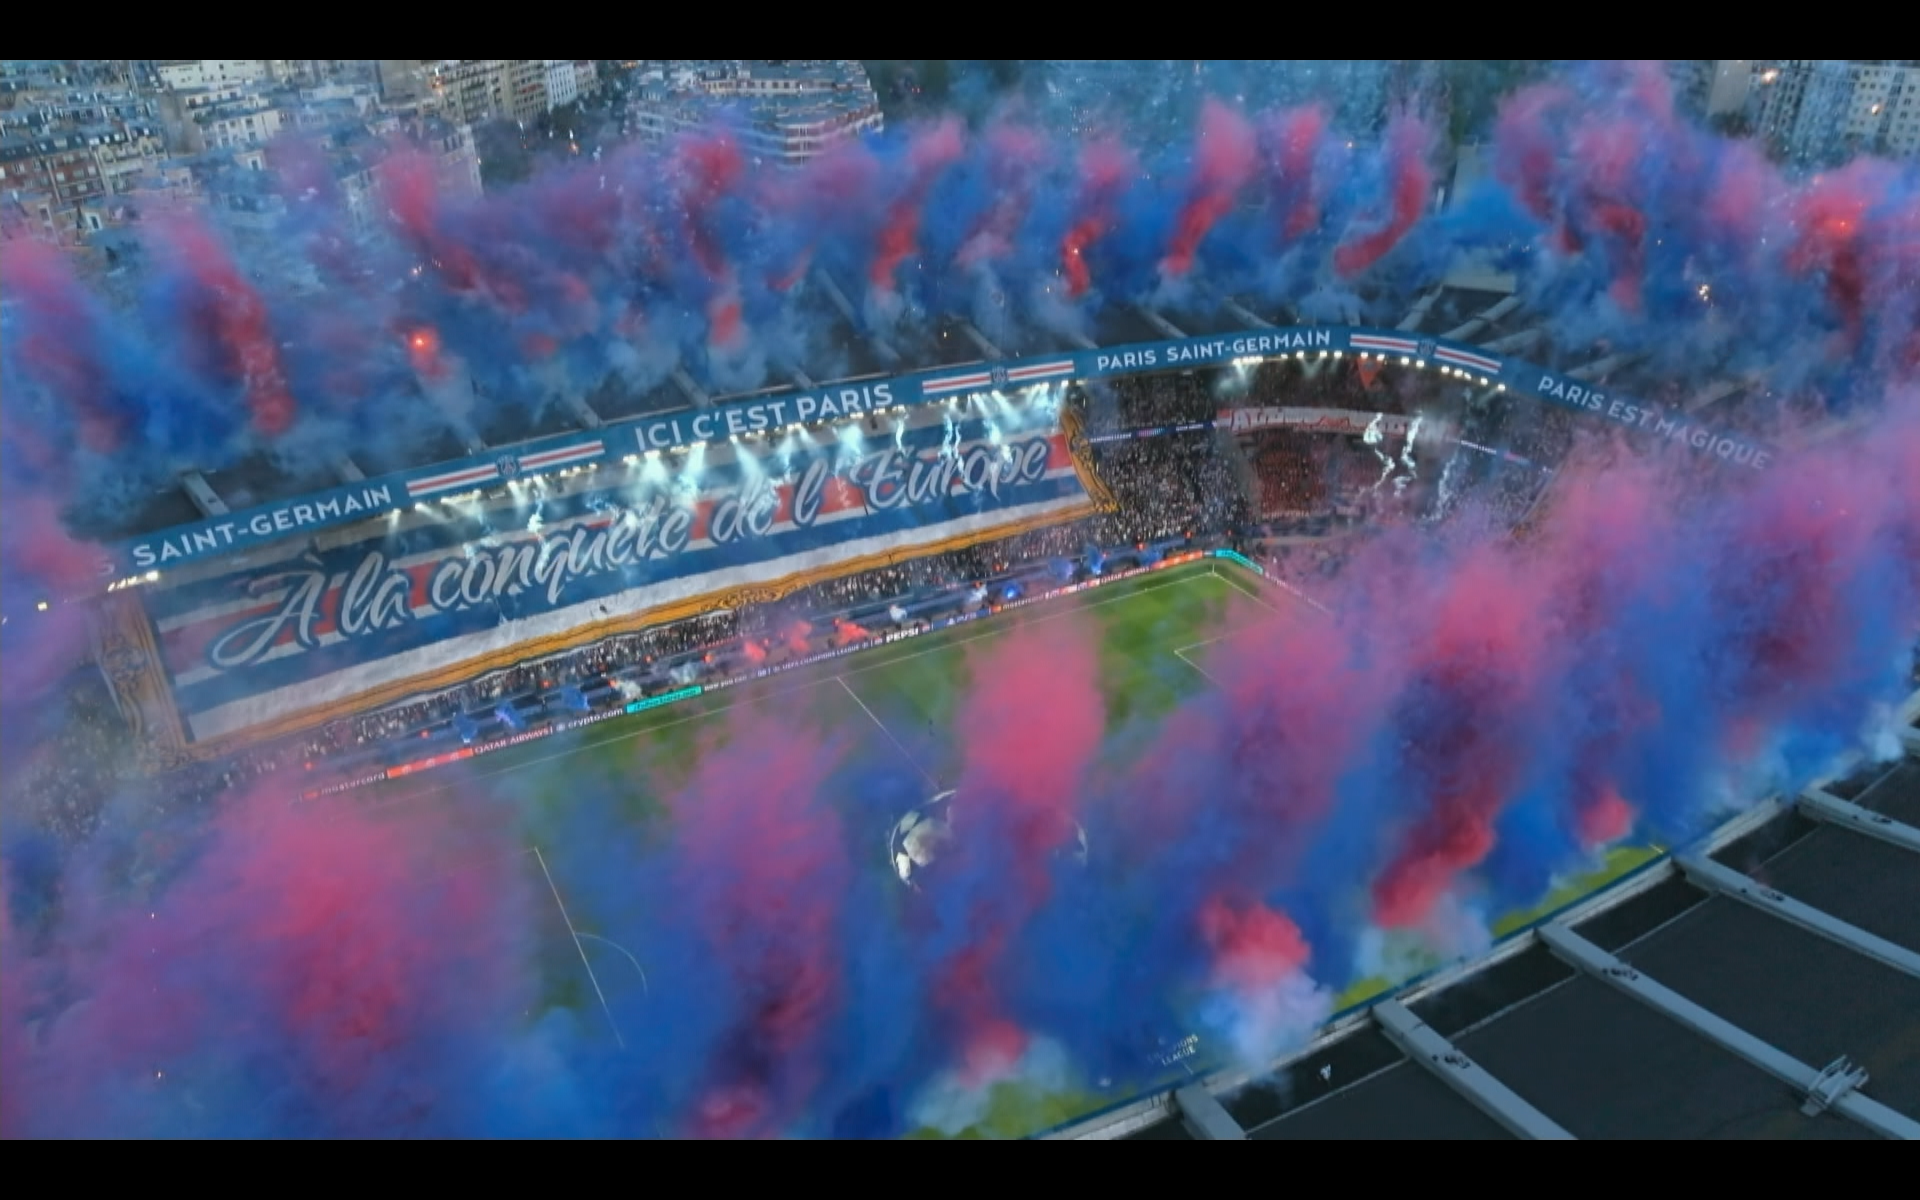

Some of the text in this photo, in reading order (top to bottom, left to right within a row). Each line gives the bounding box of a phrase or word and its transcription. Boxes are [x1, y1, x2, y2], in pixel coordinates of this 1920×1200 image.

[1097, 330, 1331, 371] PARIS SAINT-GERMAIN
[634, 383, 894, 451] ICI C'EST PARIS
[1537, 376, 1772, 469] PARIS EST MAGIQUE
[132, 485, 392, 567] SAINT-GERMAIN
[340, 553, 410, 633] la
[711, 478, 773, 539] de
[886, 627, 919, 643] PEPSI
[475, 726, 549, 754] QATAR AIRWAYS
[568, 708, 623, 729] crypto.com
